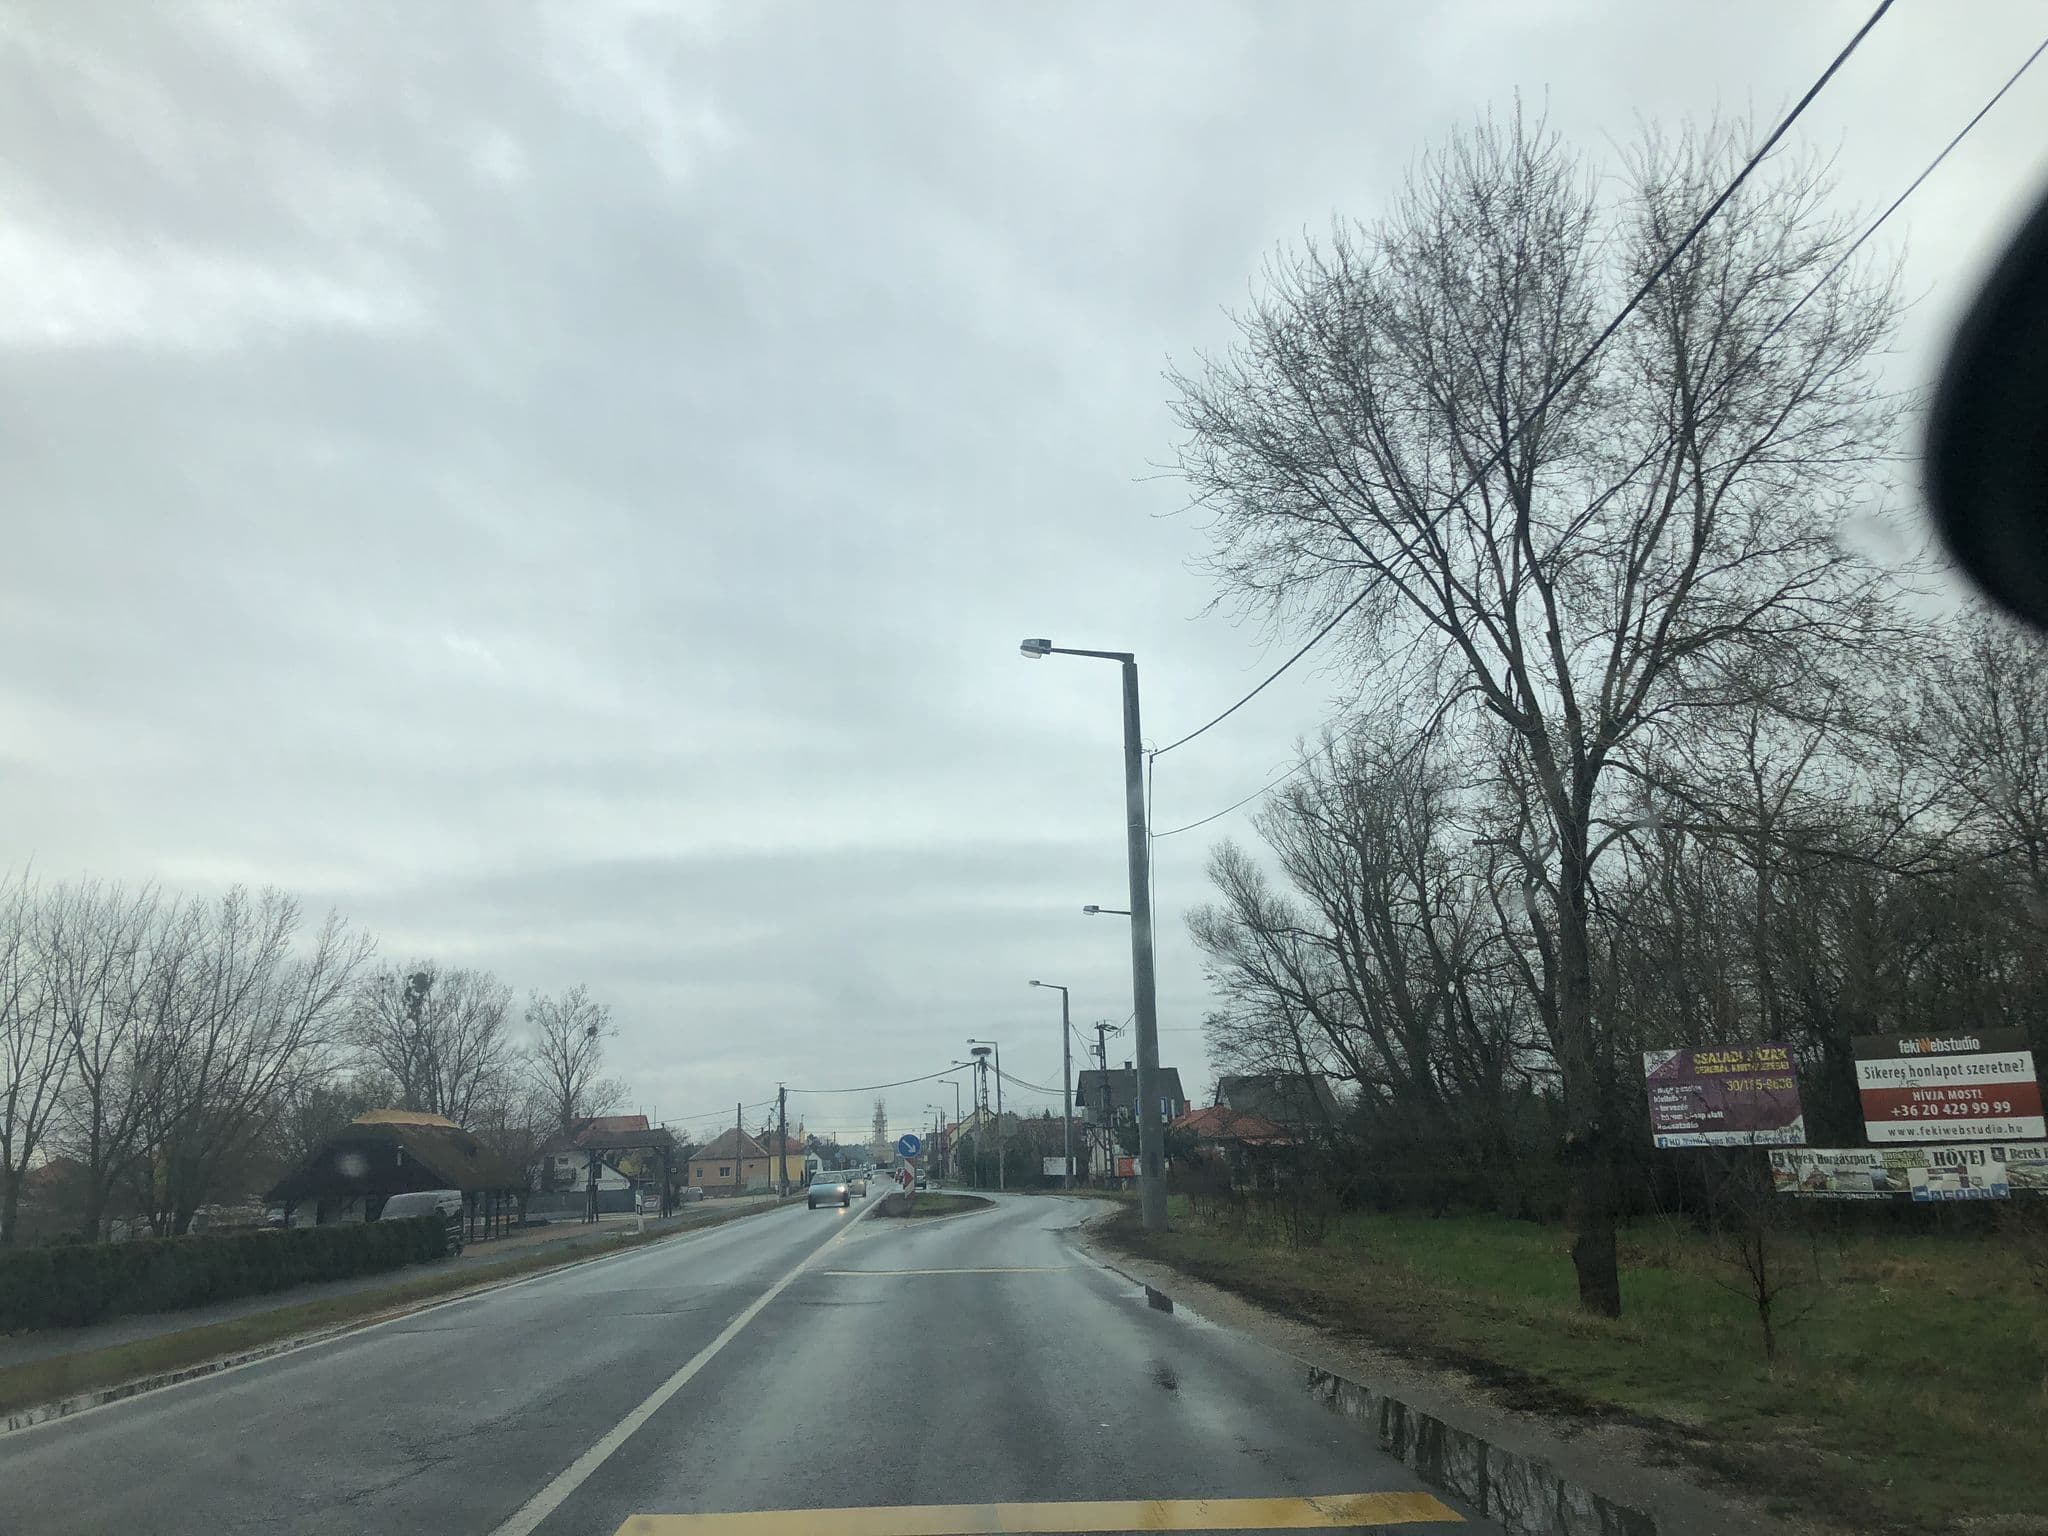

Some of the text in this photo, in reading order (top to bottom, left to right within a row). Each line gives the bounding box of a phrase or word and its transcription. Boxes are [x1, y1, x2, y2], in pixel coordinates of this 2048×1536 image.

[1864, 1058, 2025, 1080] Sikeres honlapot szeretne?
[1912, 1087, 1982, 1101] HÍVJA MOST!
[1890, 1100, 2011, 1117] +36 20 429 99 99
[1888, 1123, 2023, 1137] www.fekiwebstudio.hu
[1932, 1148, 1986, 1167] HÖVEJ
